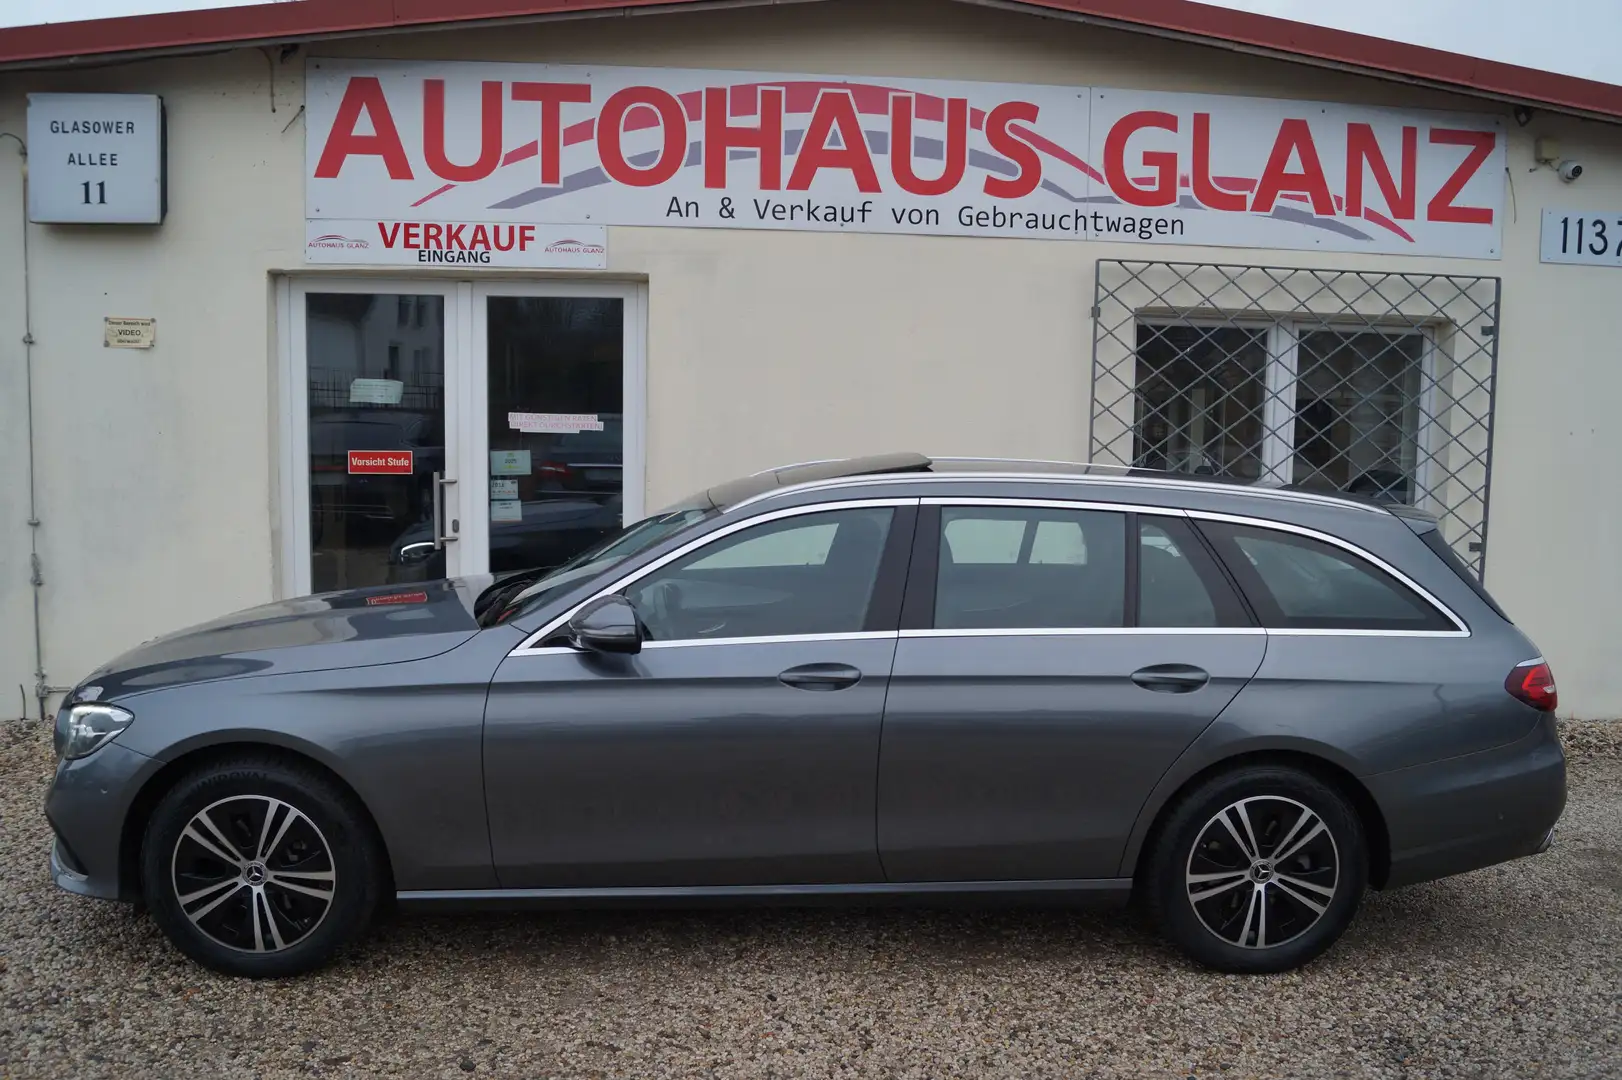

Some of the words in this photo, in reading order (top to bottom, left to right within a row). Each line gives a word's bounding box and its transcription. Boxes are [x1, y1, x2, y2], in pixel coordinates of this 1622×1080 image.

[50, 121, 135, 134] GLASOWER
[67, 153, 118, 166] ALLEE
[314, 77, 1041, 199] AUTOHAUS
[1104, 111, 1496, 225] GLANZ
[81, 181, 107, 205] 11
[666, 196, 699, 218] An
[719, 197, 735, 219] &
[754, 199, 872, 222] Verkauf
[892, 207, 939, 225] von
[958, 206, 1184, 239] Gebrauchtwagen
[378, 222, 535, 252] VERKAUF
[418, 250, 491, 264] EINGANG
[351, 457, 385, 466] Vorsicht
[387, 457, 409, 466] Stufe
